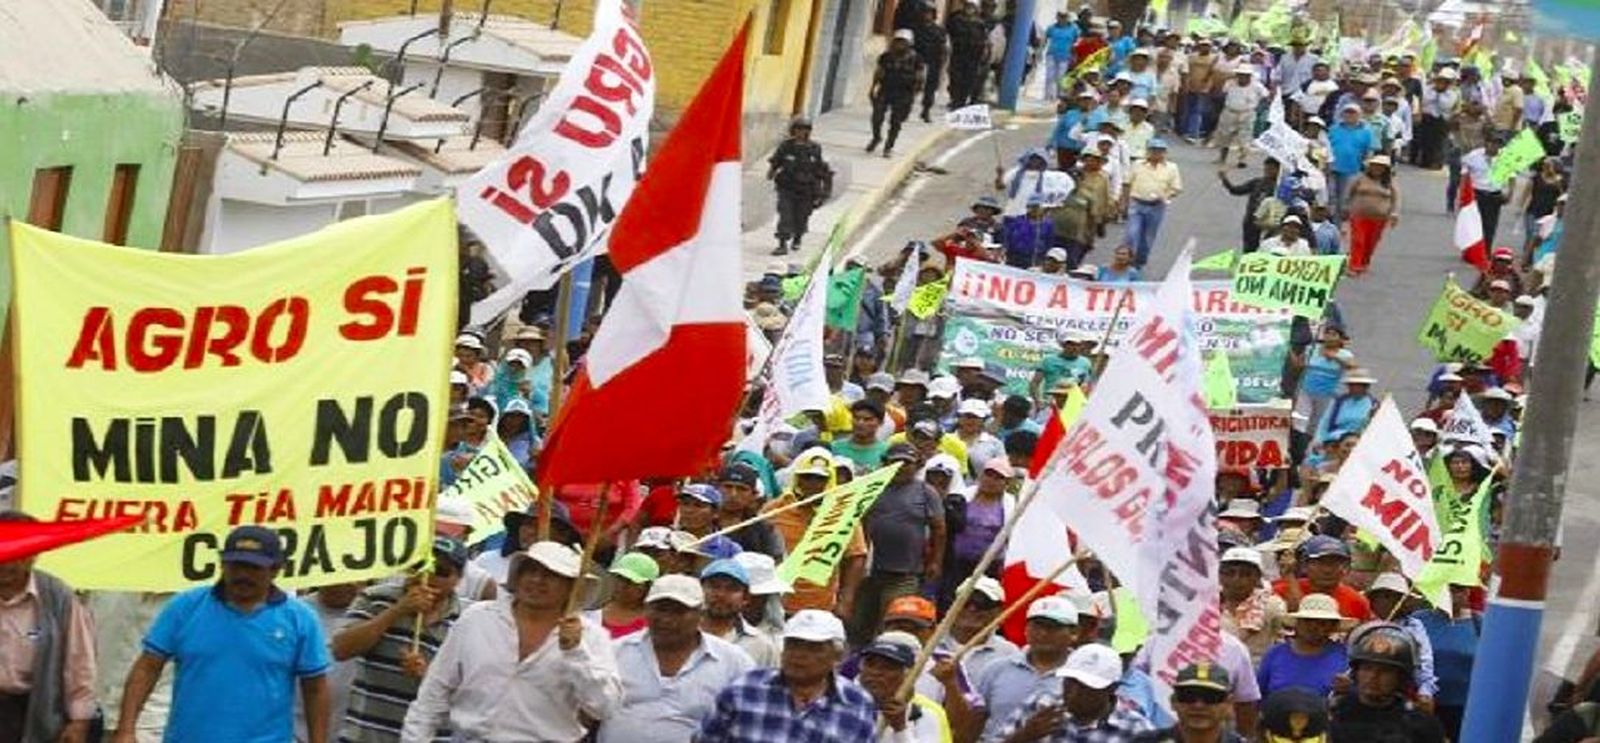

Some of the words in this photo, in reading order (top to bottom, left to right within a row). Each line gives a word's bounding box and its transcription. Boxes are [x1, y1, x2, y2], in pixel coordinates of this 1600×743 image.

[1047, 283, 1069, 309] A
[1085, 287, 1136, 313] TIA
[66, 296, 310, 372] AGRO
[310, 391, 430, 467] NO
[55, 498, 198, 533] FUERA
[314, 476, 430, 518] MARI
[1381, 458, 1426, 498] NO
[182, 516, 419, 581] CRAJO
